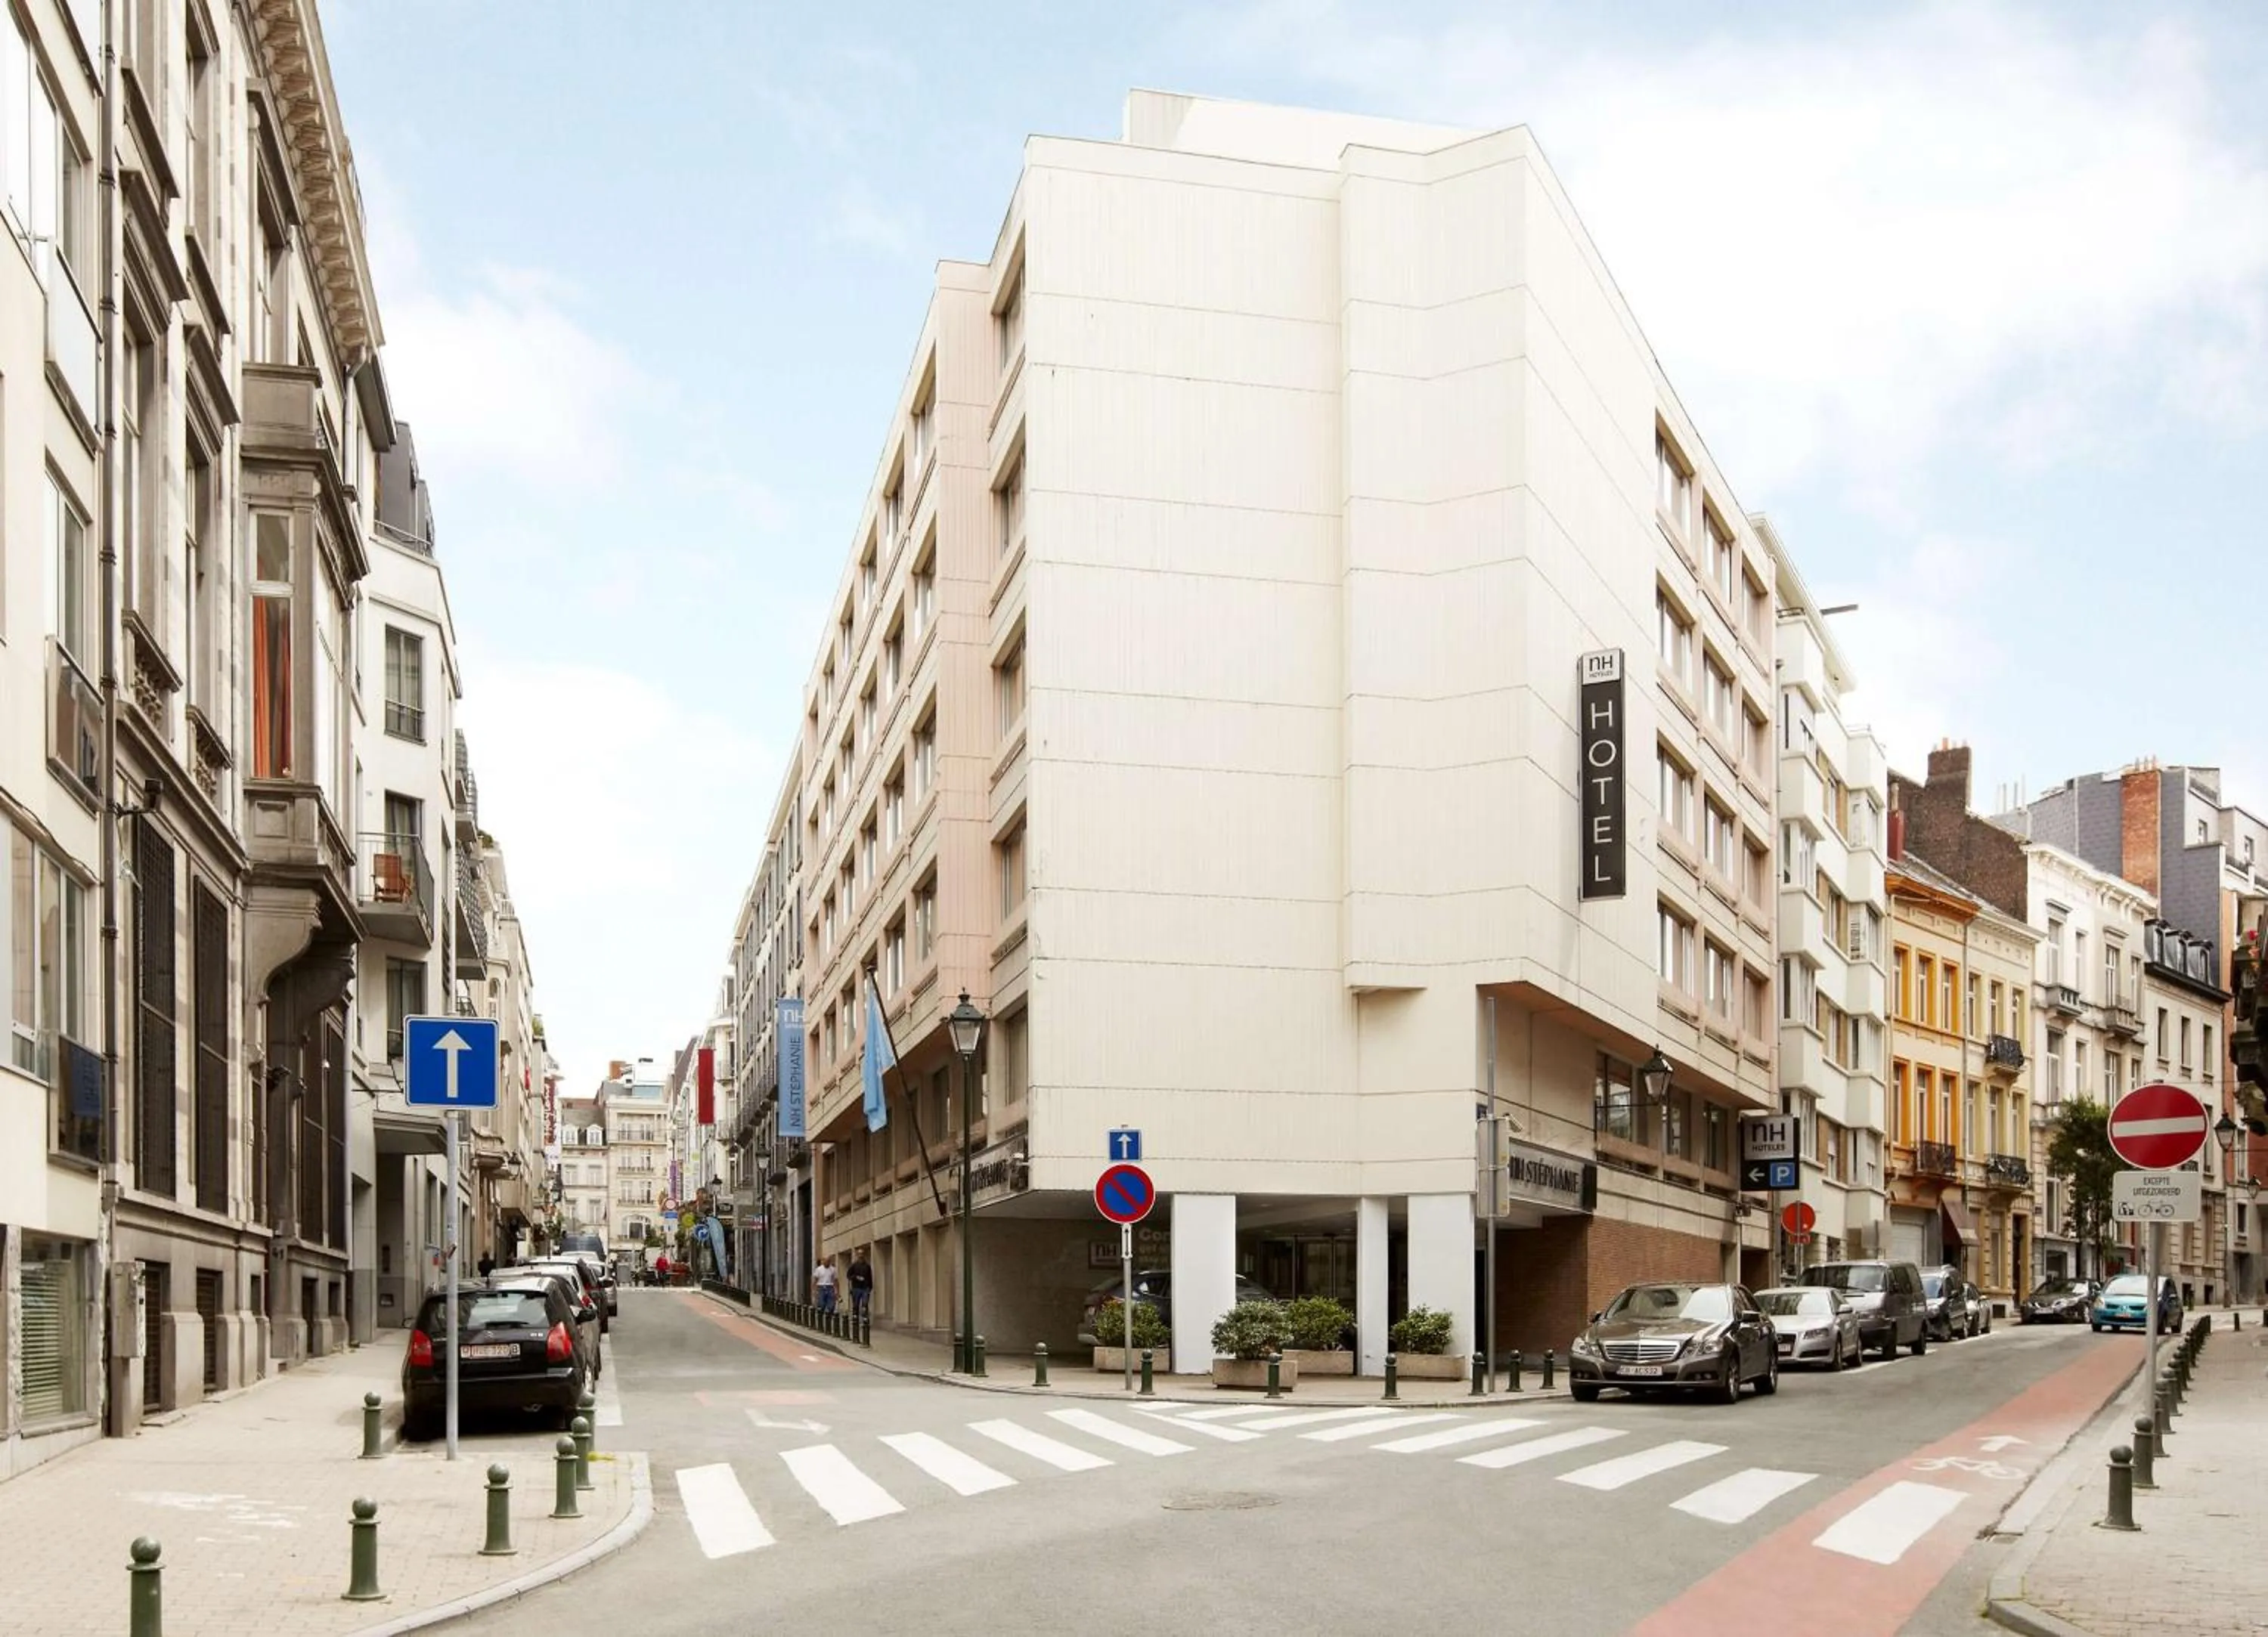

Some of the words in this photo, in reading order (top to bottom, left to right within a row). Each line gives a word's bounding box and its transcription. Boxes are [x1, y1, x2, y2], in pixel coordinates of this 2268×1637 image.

[1588, 700, 1617, 882] HOTEL
[790, 1109, 801, 1128] NH
[1777, 1166, 1790, 1183] P
